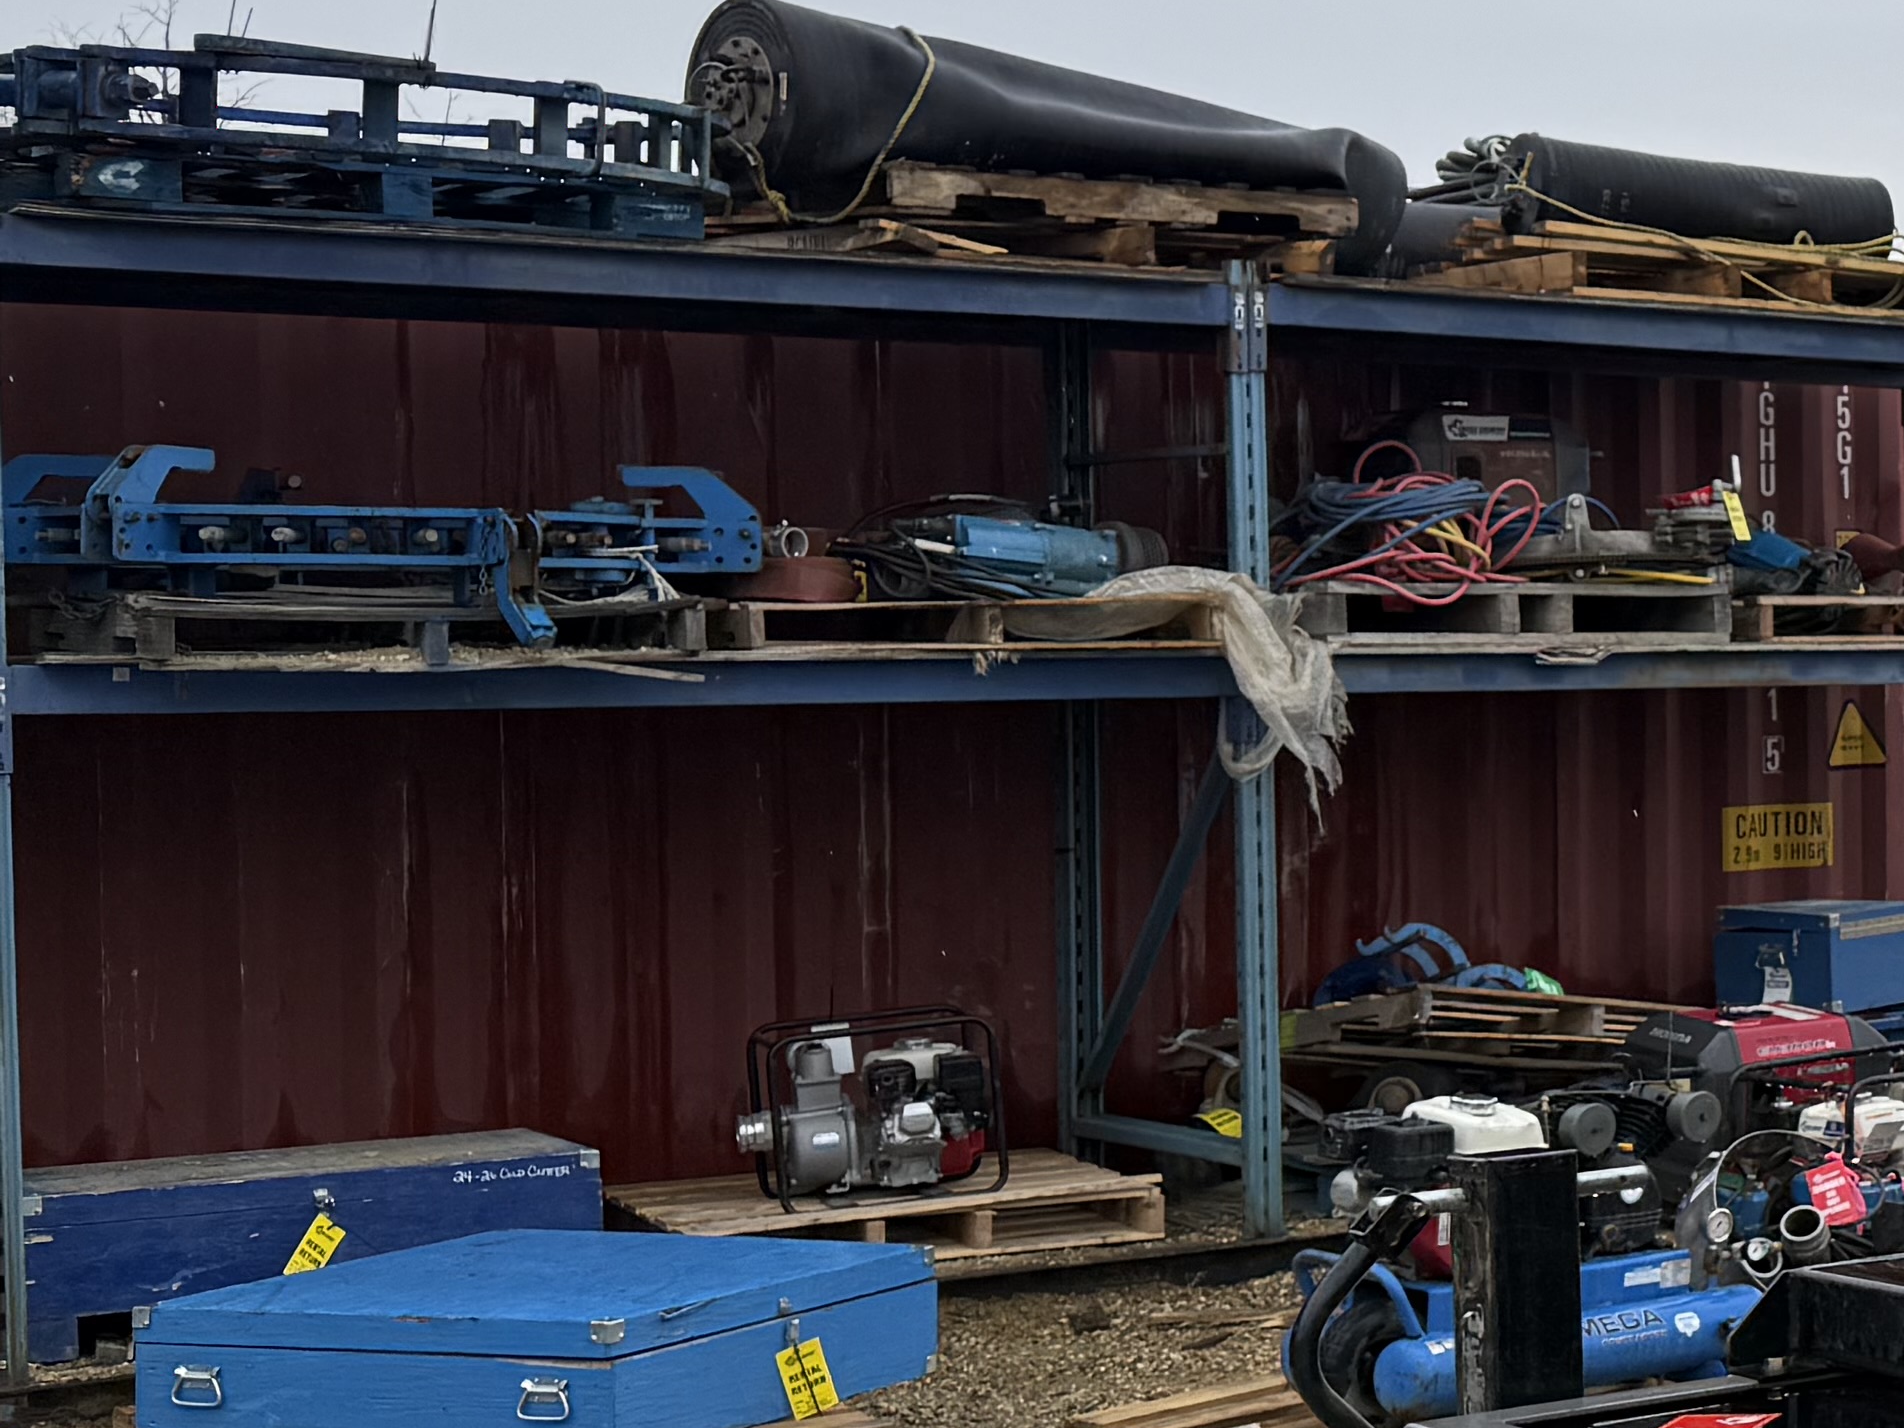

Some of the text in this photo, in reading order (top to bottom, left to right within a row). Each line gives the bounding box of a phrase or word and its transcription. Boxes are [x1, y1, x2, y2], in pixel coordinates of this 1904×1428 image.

[1758, 381, 1776, 497] GHU
[1836, 384, 1852, 499] 5G1
[1766, 738, 1781, 771] 5
[1736, 811, 1823, 839] CAUTION
